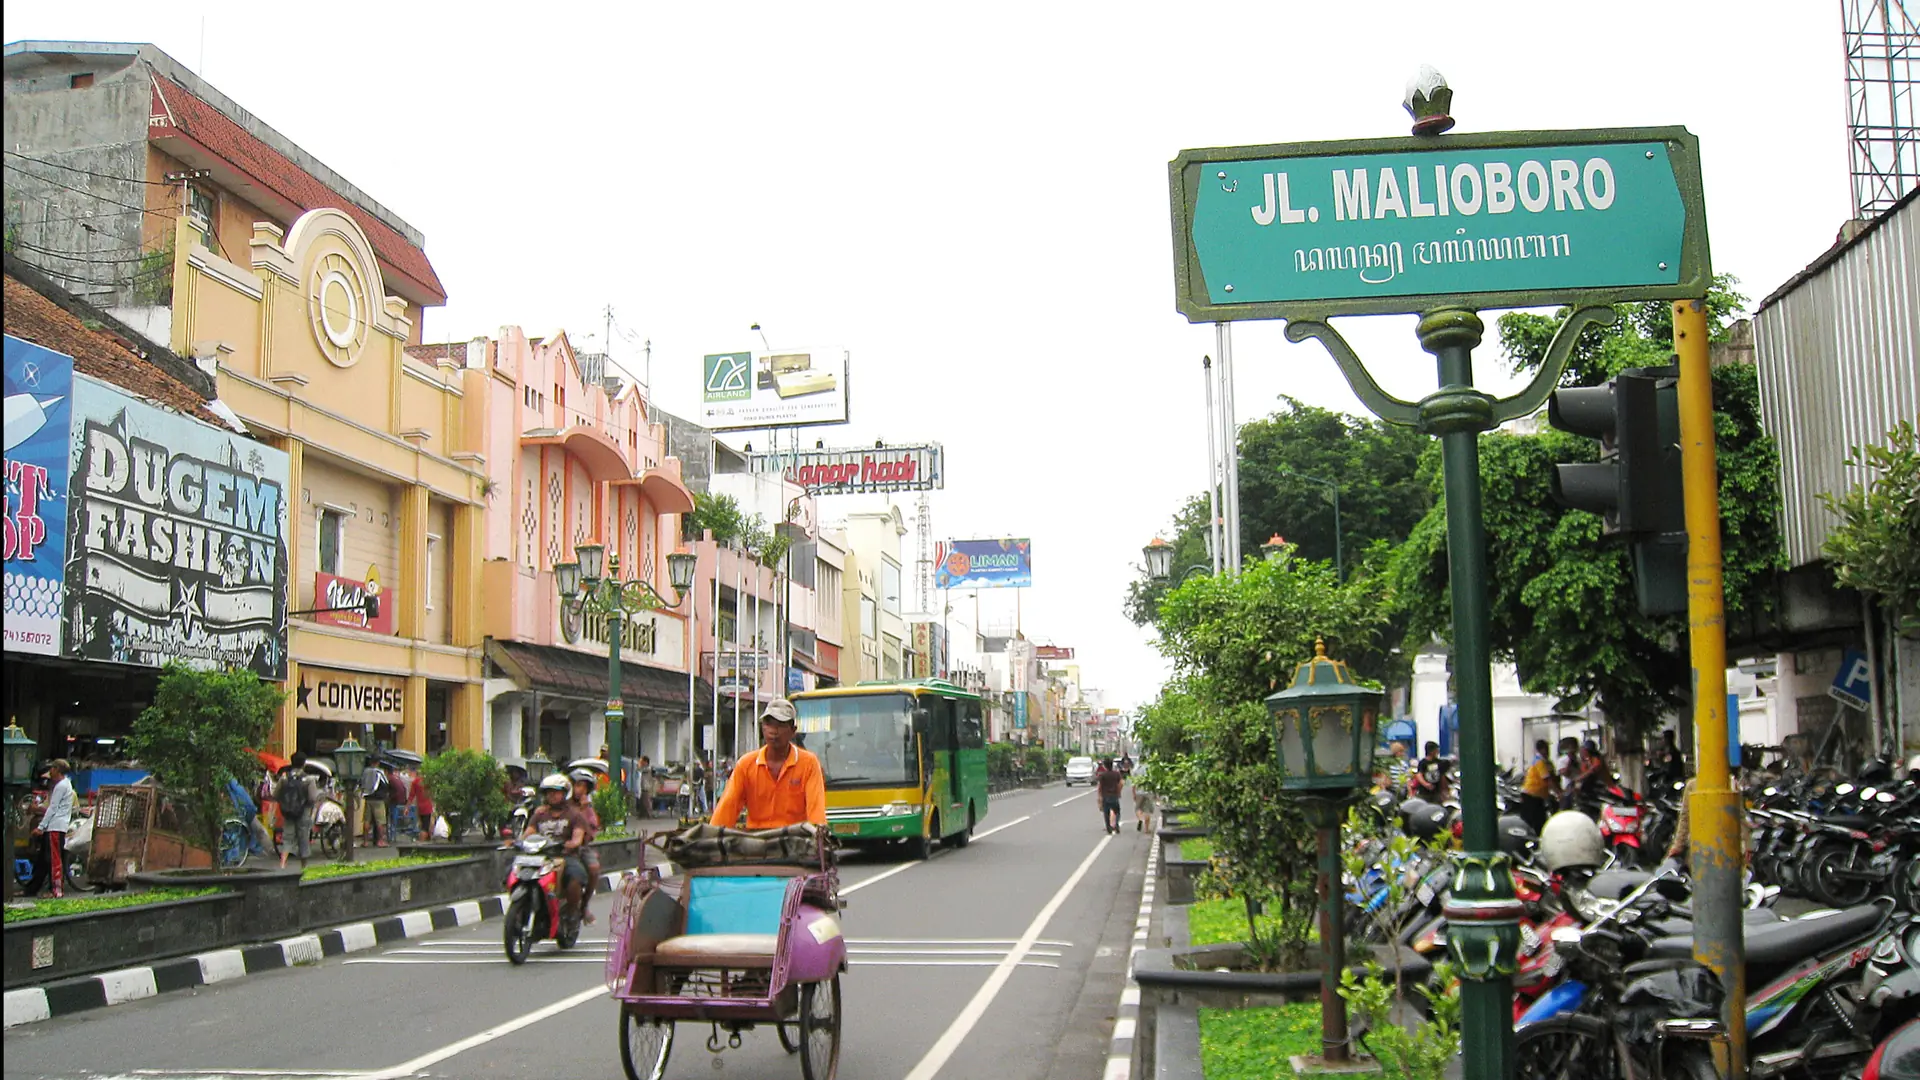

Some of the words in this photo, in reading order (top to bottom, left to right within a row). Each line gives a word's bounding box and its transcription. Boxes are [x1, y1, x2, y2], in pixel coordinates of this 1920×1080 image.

[1252, 172, 1319, 226] JL.
[1332, 157, 1616, 221] MALIOBORO
[707, 390, 746, 399] AIRLAND
[4, 458, 47, 517] T
[86, 429, 278, 537] DUGEM
[970, 554, 1019, 568] LIMAN
[326, 579, 367, 627] Italy
[582, 611, 657, 655] maahari
[1844, 658, 1870, 688] P
[317, 681, 402, 712] CONVERSE
